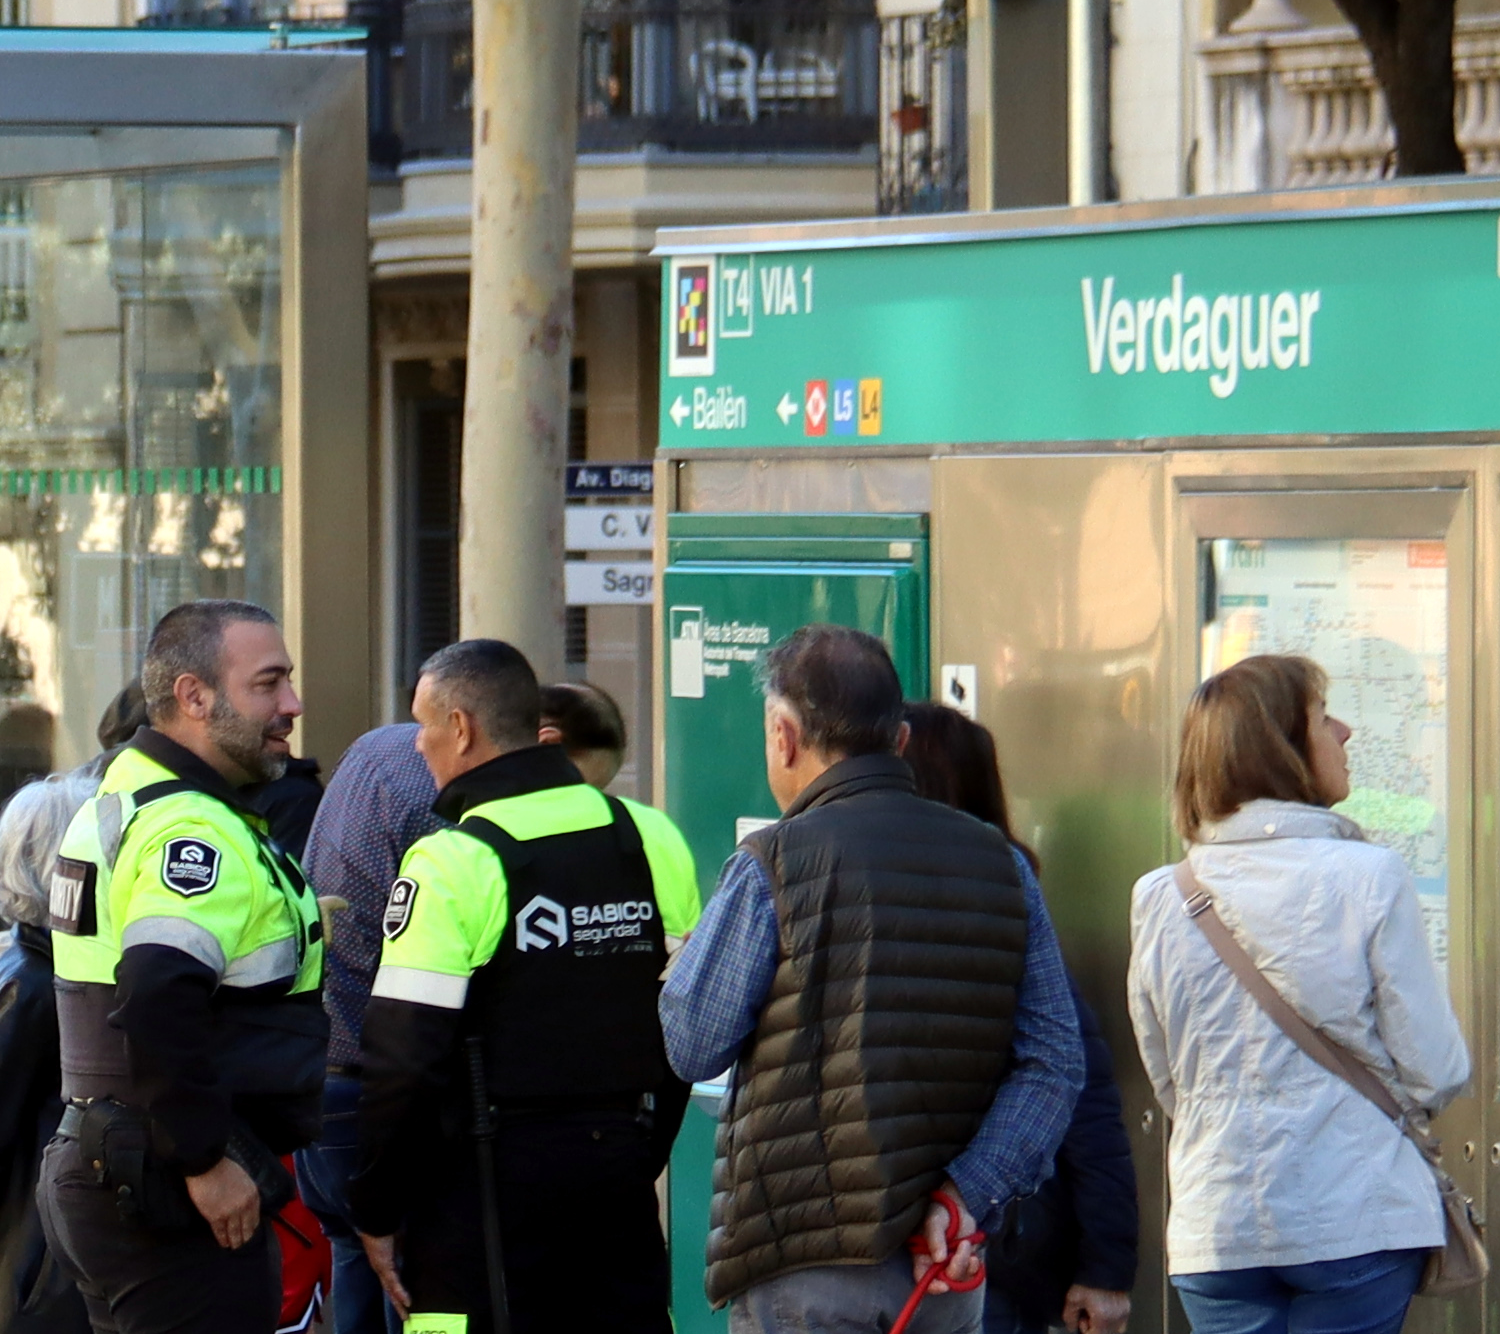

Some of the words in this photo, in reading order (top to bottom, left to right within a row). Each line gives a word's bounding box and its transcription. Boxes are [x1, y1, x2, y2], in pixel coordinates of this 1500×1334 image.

[722, 268, 750, 317] T4
[760, 266, 798, 316] VIA
[802, 266, 813, 314] 1
[1080, 272, 1322, 399] Verdaguer
[833, 388, 852, 422] L5
[860, 389, 879, 420] L4
[575, 469, 605, 488] Av.
[609, 469, 654, 492] Diag
[601, 514, 627, 538] C.
[571, 901, 653, 927] SABICO
[572, 922, 642, 944] seguridad
